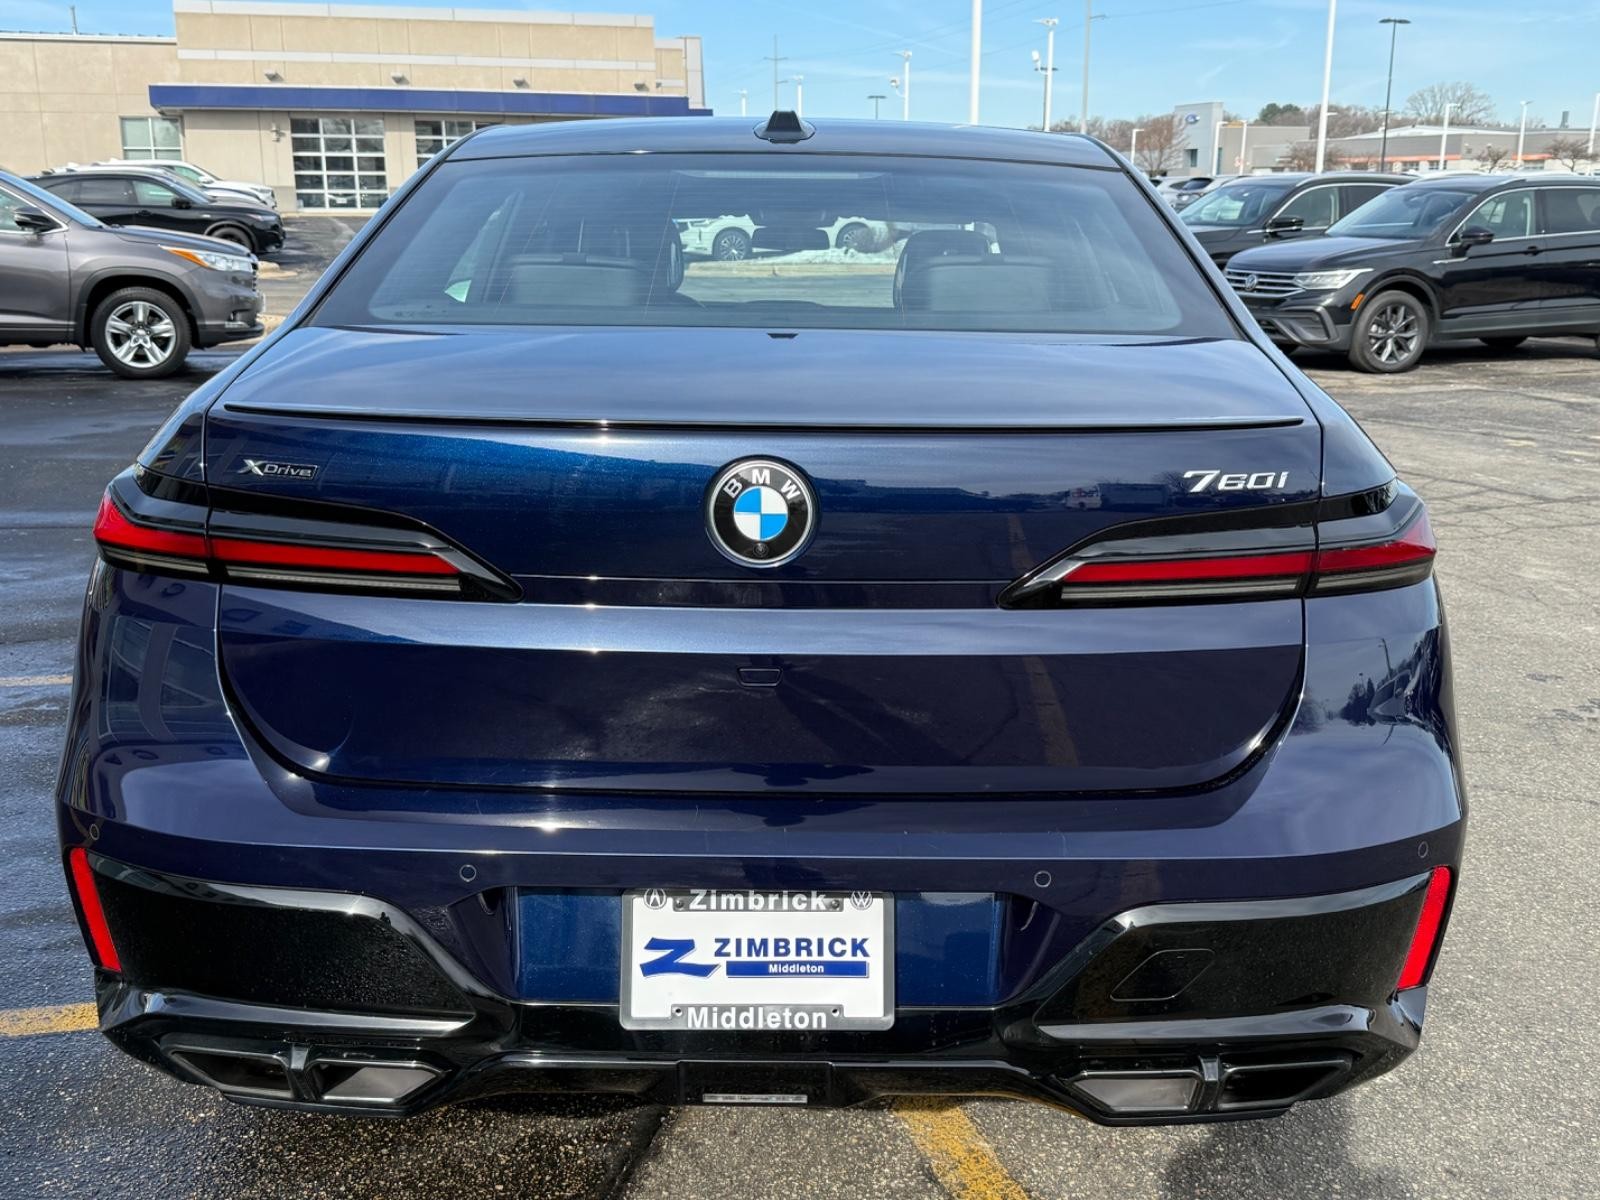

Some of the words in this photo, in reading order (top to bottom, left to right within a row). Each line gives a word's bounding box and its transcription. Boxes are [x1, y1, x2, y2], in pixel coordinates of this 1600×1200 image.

[722, 468, 802, 500] BMW
[1183, 469, 1290, 493] 760i
[689, 889, 827, 911] Zimbrick
[713, 937, 870, 958] ZIMBRICK
[769, 962, 825, 974] Middleton
[687, 1006, 827, 1029] Middleton
